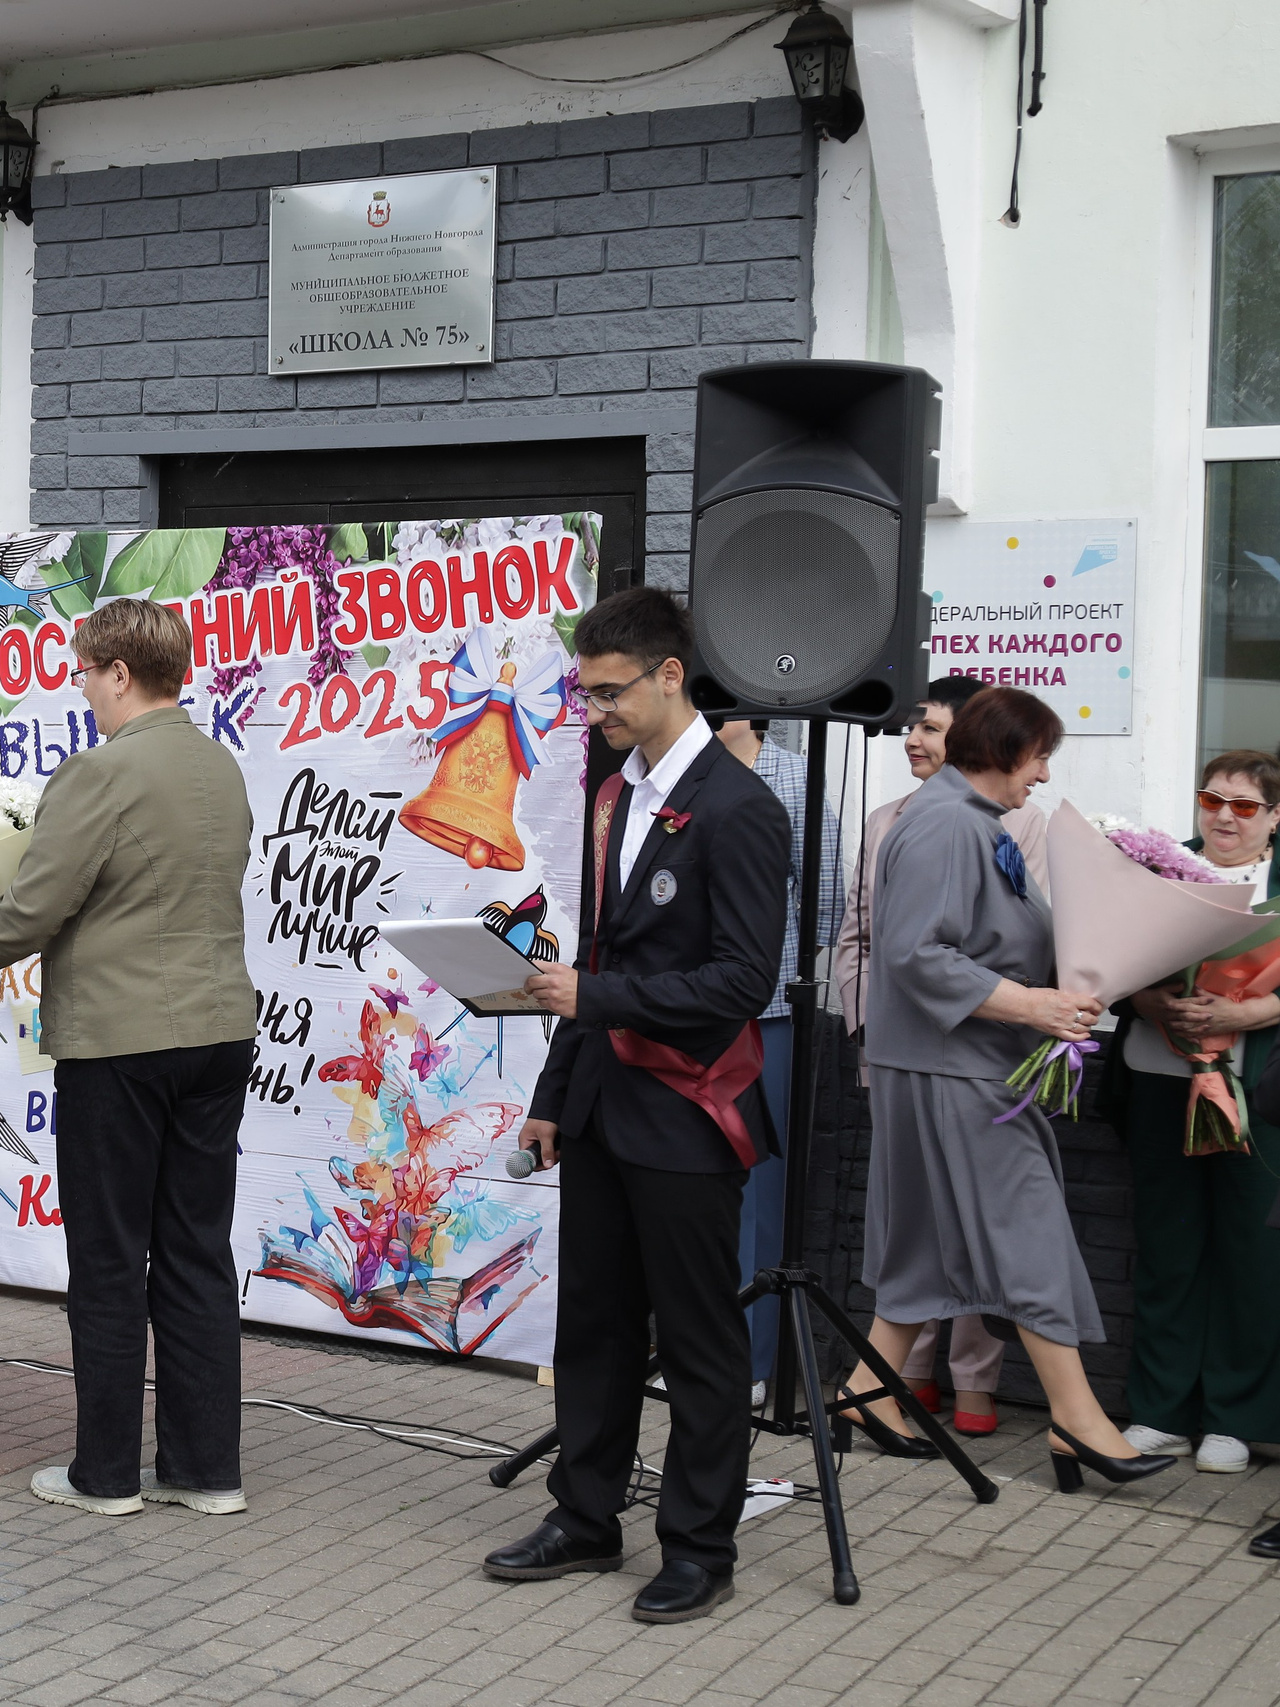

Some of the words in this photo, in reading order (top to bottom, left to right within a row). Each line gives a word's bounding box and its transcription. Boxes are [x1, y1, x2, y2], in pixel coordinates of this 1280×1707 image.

[291, 239, 358, 252] Администрация
[359, 237, 388, 247] города
[390, 232, 432, 243] Нижнего
[434, 228, 484, 239] Новгорода
[328, 250, 384, 262] Департамент
[386, 245, 442, 257] образования
[290, 275, 390, 291] МУНИЦИПАЛЬНОЕ
[393, 268, 470, 284] БЮДЖЕТНОЕ
[309, 284, 448, 303] ОБЩЕОБРАЗОВАТЕЛЬНОЕ
[339, 301, 416, 315] УЧРЕЖДЕНИЕ
[288, 329, 394, 355] «ШКОЛА
[400, 327, 428, 347] №
[435, 325, 470, 346] 75»
[335, 537, 579, 645] ЗВОНОК
[930, 602, 1042, 625] ДЕРАЛЬНЫЙ
[1048, 603, 1124, 620] ПРОЕКТ
[931, 634, 980, 654] ПЕХ
[988, 633, 1122, 657] КАЖДОГО
[278, 660, 455, 751] 2025
[271, 842, 381, 923] Мир
